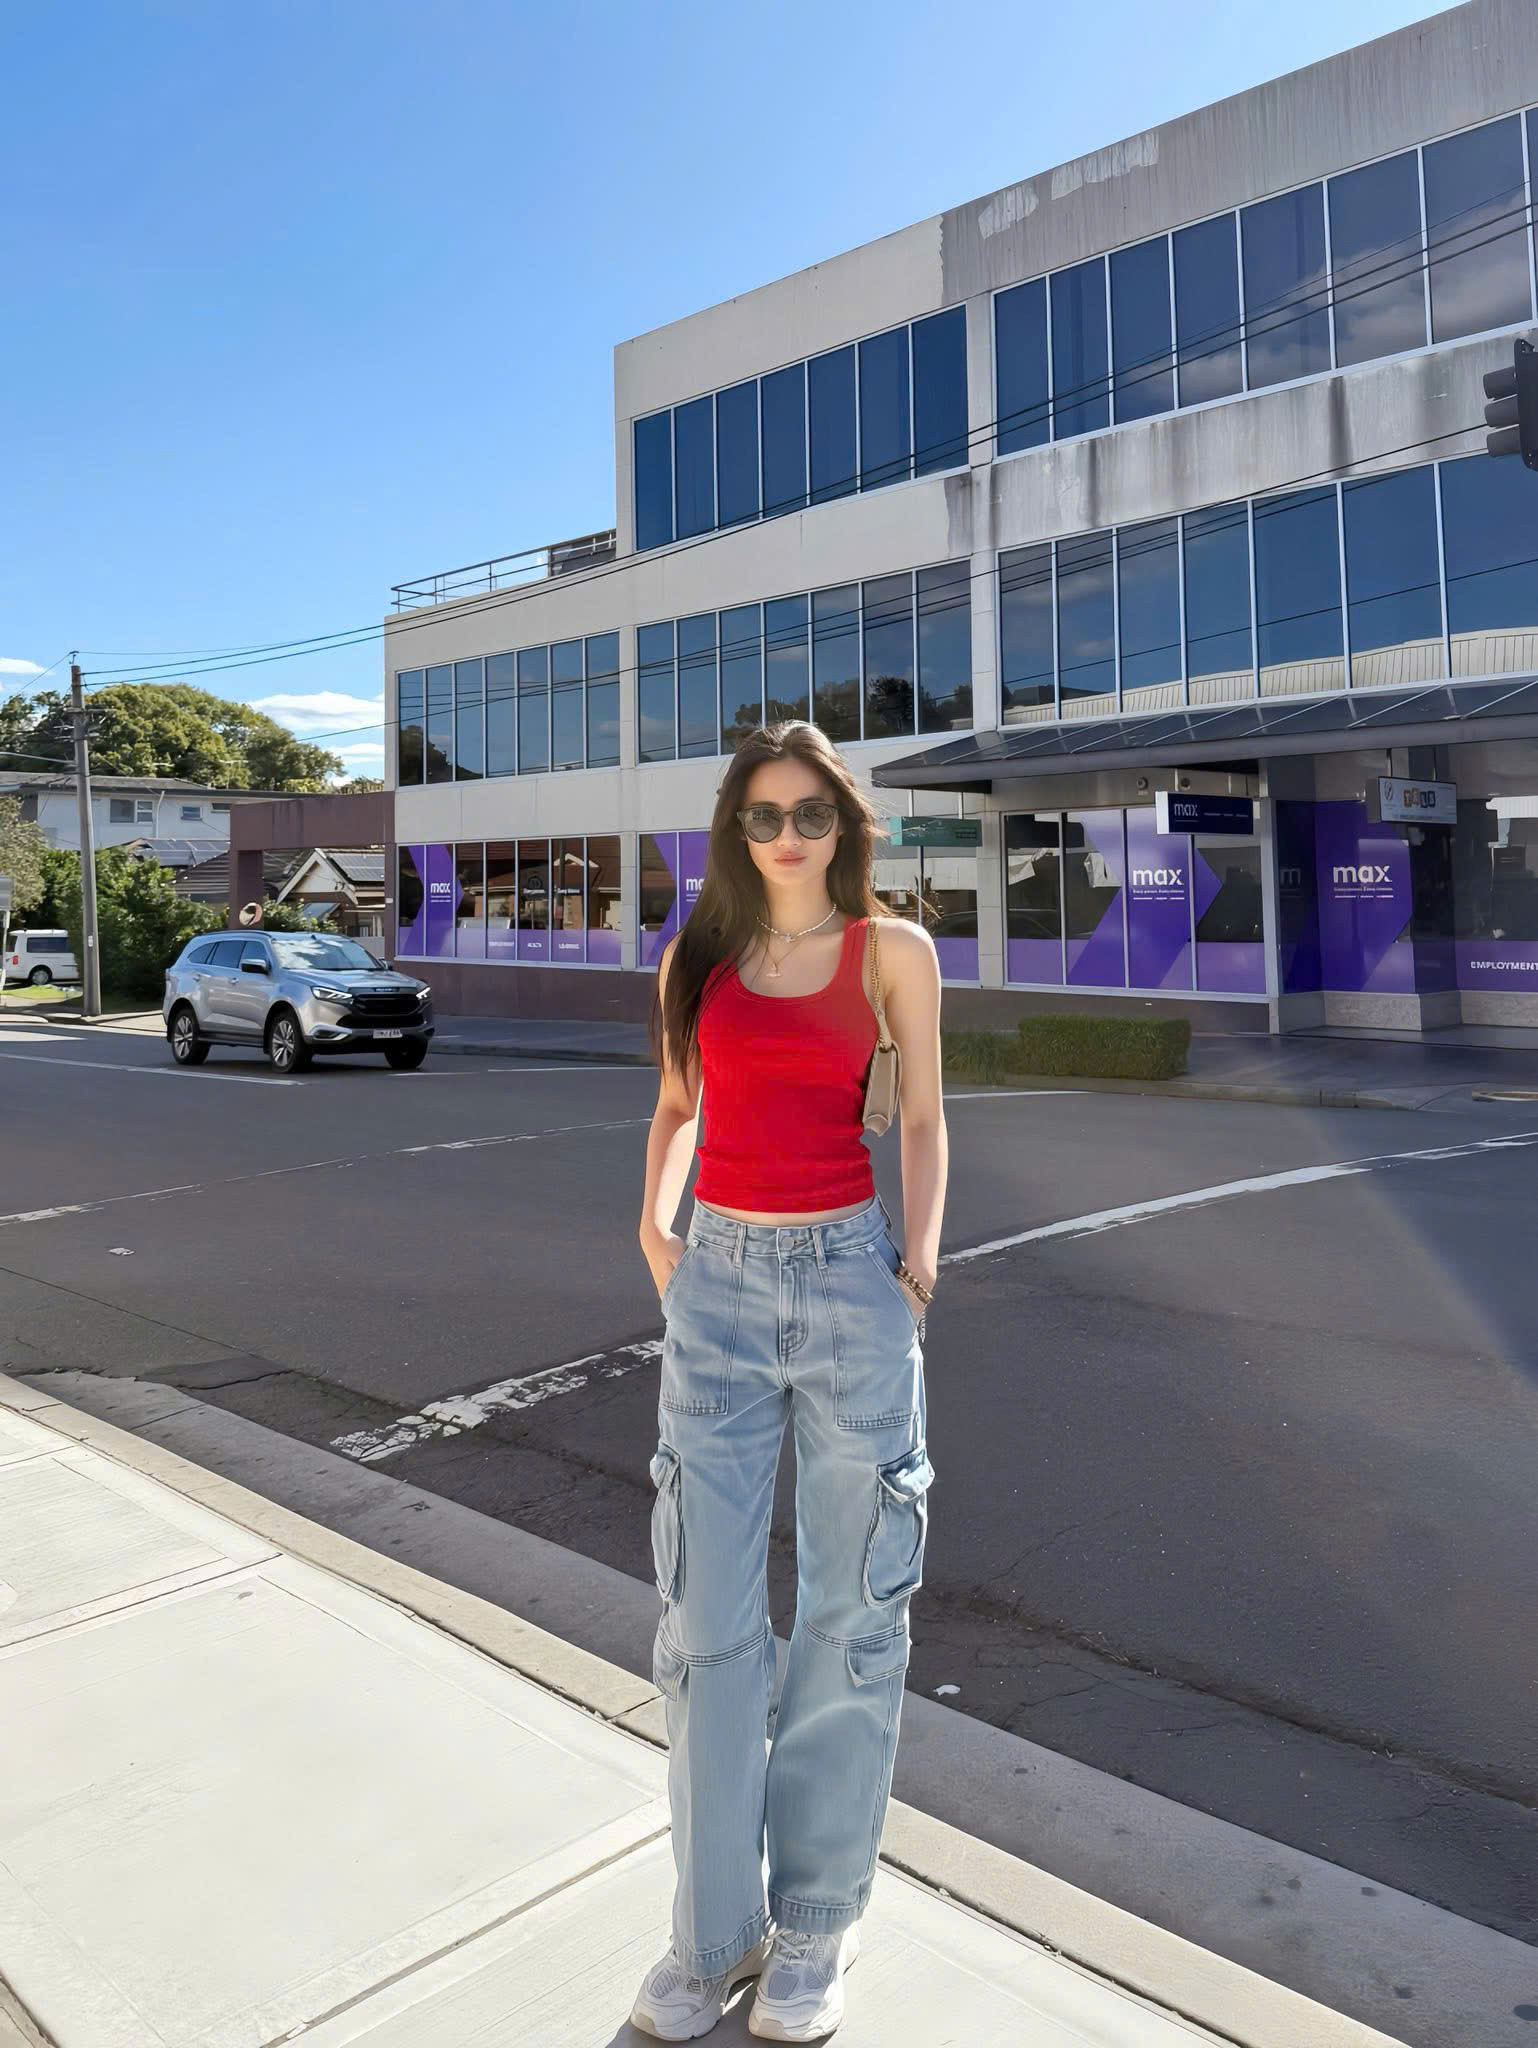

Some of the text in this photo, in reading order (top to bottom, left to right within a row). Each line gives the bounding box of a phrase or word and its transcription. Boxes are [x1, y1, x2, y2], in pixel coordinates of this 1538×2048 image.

[1174, 803, 1198, 816] max
[1132, 869, 1184, 886] max
[1333, 866, 1393, 883] max
[430, 883, 451, 894] max
